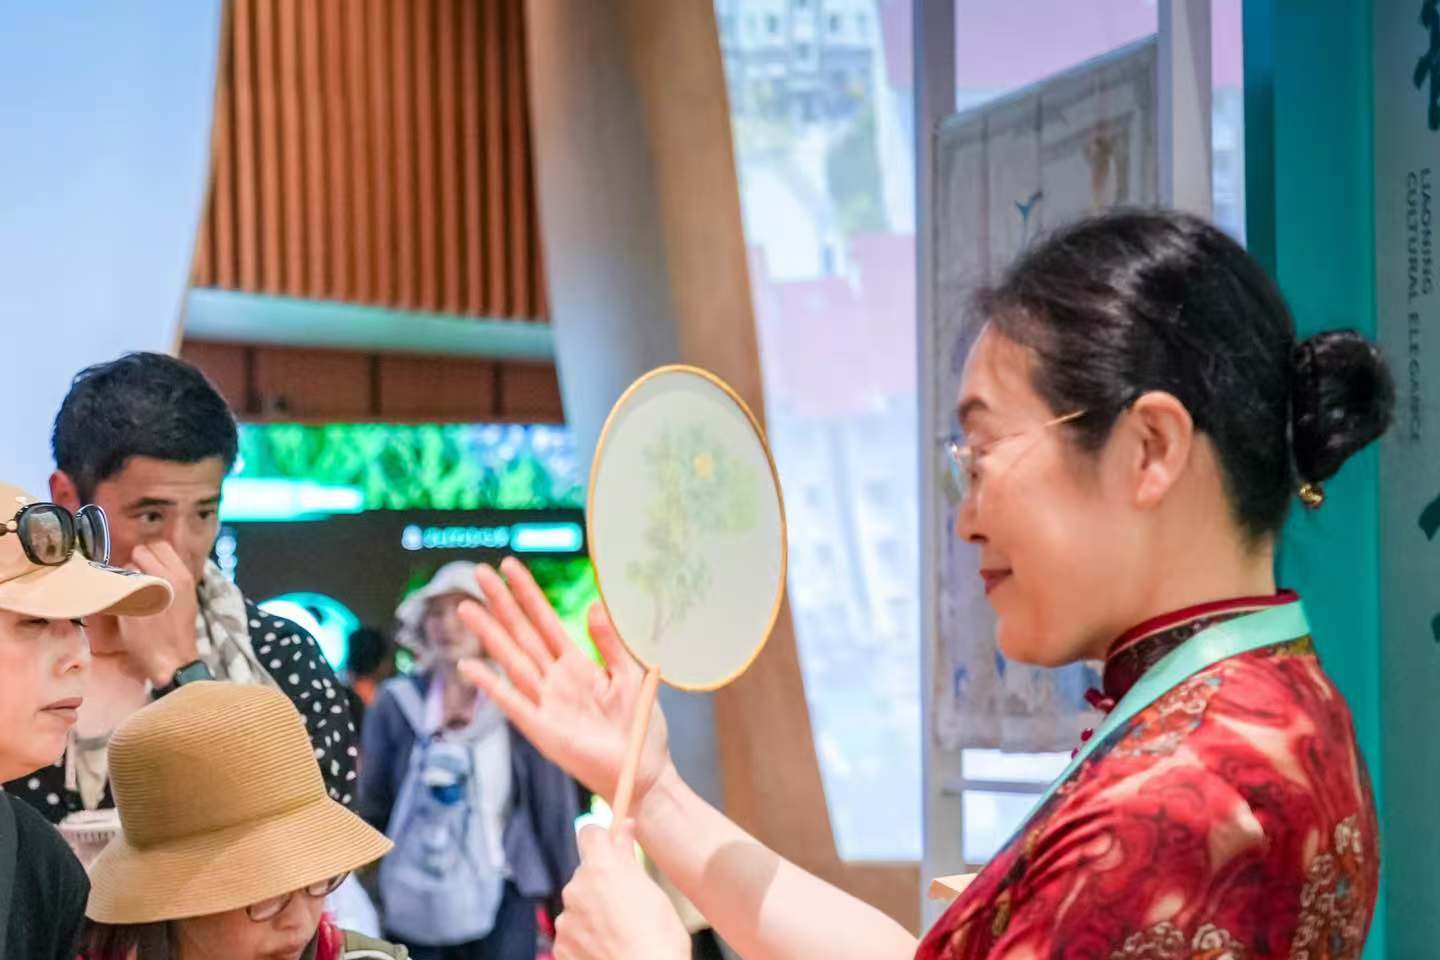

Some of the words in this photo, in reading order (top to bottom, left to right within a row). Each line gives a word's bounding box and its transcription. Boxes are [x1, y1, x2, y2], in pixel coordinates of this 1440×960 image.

[1407, 171, 1419, 305] CULTURAL
[1421, 167, 1433, 296] LIAONING
[1408, 311, 1421, 442] ELEGANCE
